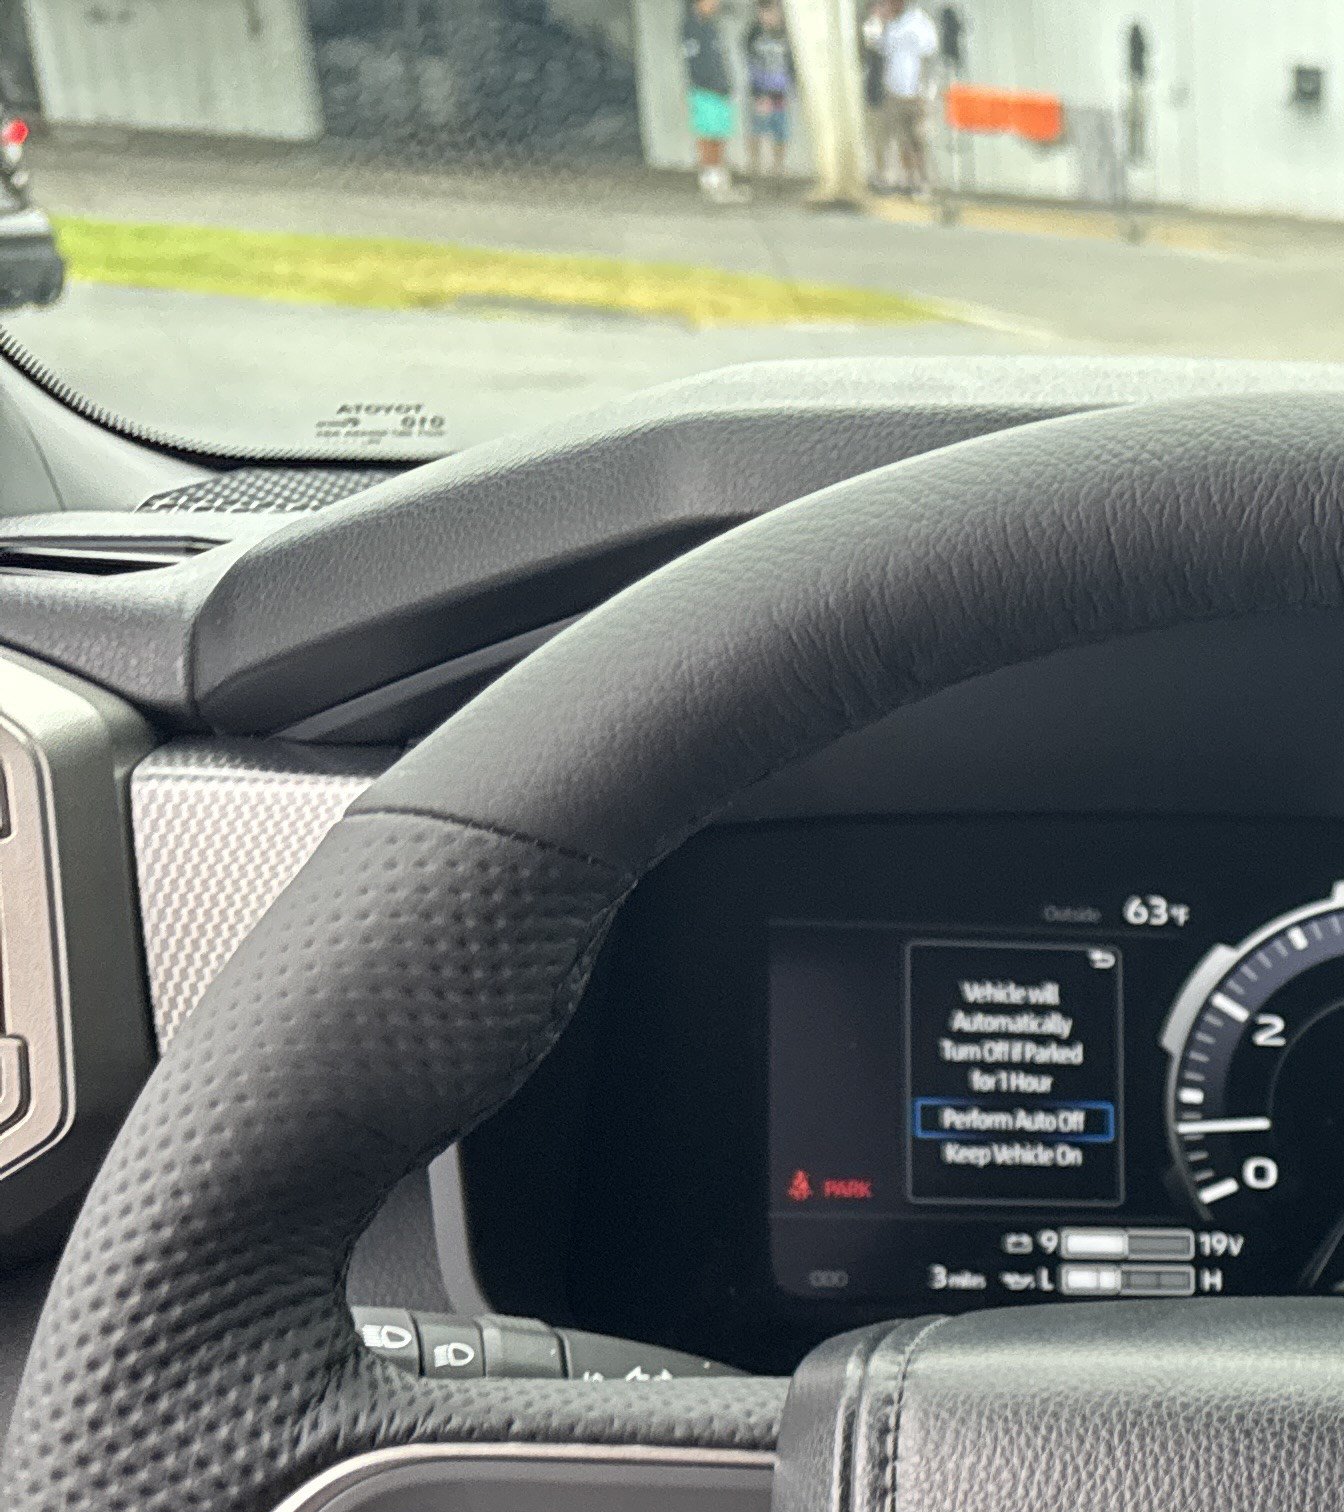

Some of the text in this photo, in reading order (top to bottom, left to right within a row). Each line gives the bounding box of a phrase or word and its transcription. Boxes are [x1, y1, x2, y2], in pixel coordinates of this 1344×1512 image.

[959, 979, 1060, 1006] Vehicle will
[949, 1009, 1073, 1040] Automatically
[1252, 1016, 1287, 1046] 2
[940, 1038, 981, 1063] Turn
[982, 1039, 1009, 1064] Off
[1023, 1041, 1083, 1065] Parked
[968, 1068, 1053, 1093] for 1 Hour
[940, 1107, 1086, 1132] Perform Auto Off
[942, 1142, 1084, 1168] Keep Vehicle On
[1243, 1158, 1277, 1188] 0
[1039, 1229, 1059, 1255] 9
[1199, 1232, 1243, 1257] 19V
[928, 1263, 947, 1290] 3
[1040, 1267, 1055, 1291] L
[1203, 1268, 1222, 1290] H
